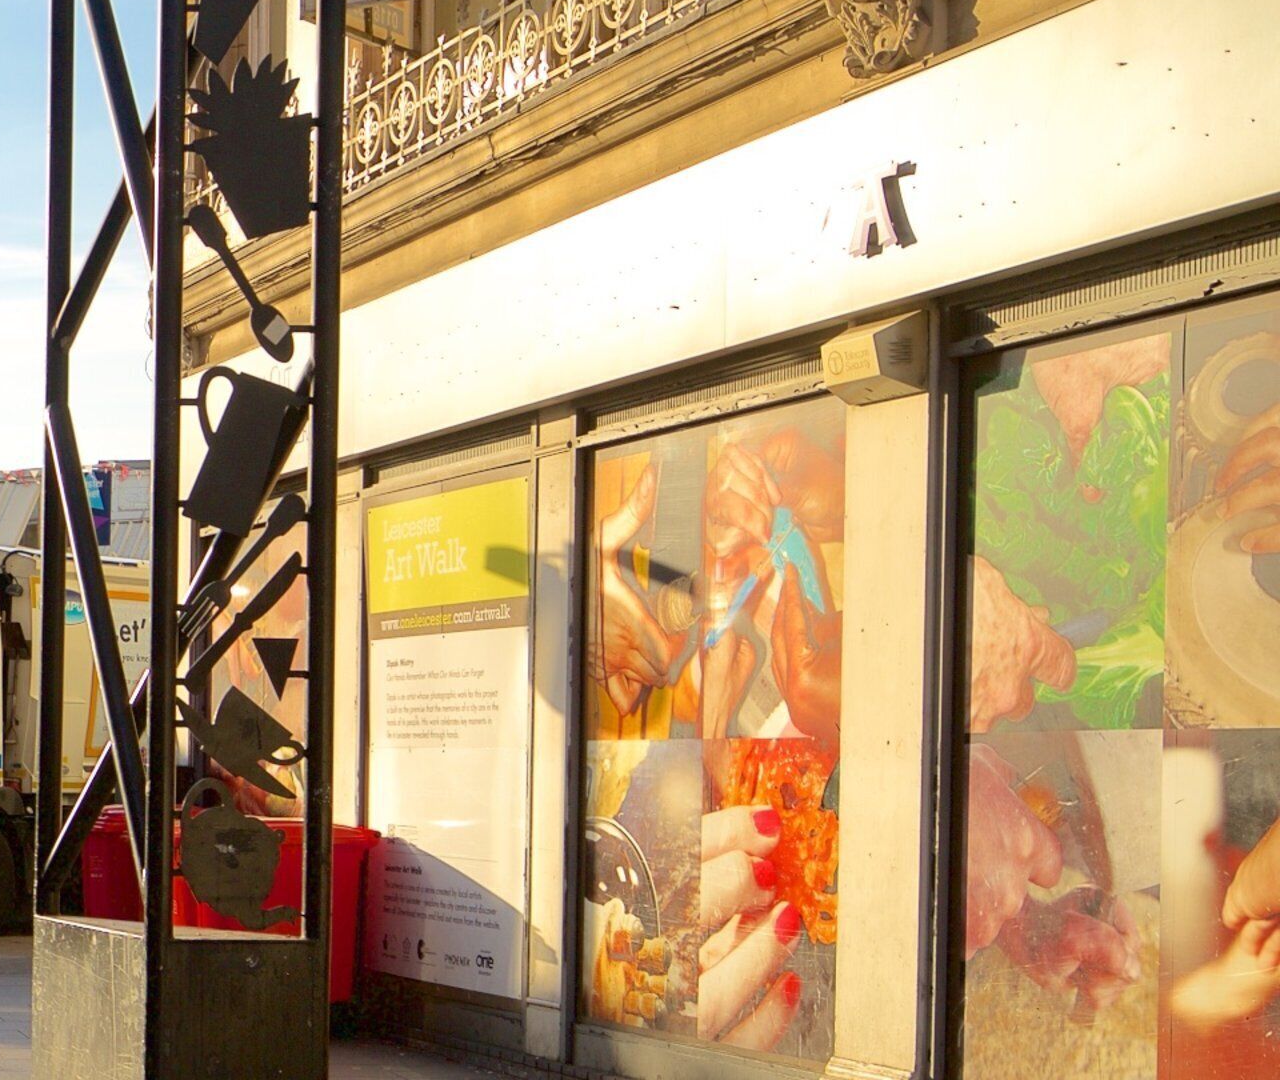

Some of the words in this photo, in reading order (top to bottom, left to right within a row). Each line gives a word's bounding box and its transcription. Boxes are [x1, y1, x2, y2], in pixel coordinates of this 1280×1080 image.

[383, 515, 443, 542] Leicester
[383, 548, 414, 584] Art
[415, 536, 468, 579] Walk
